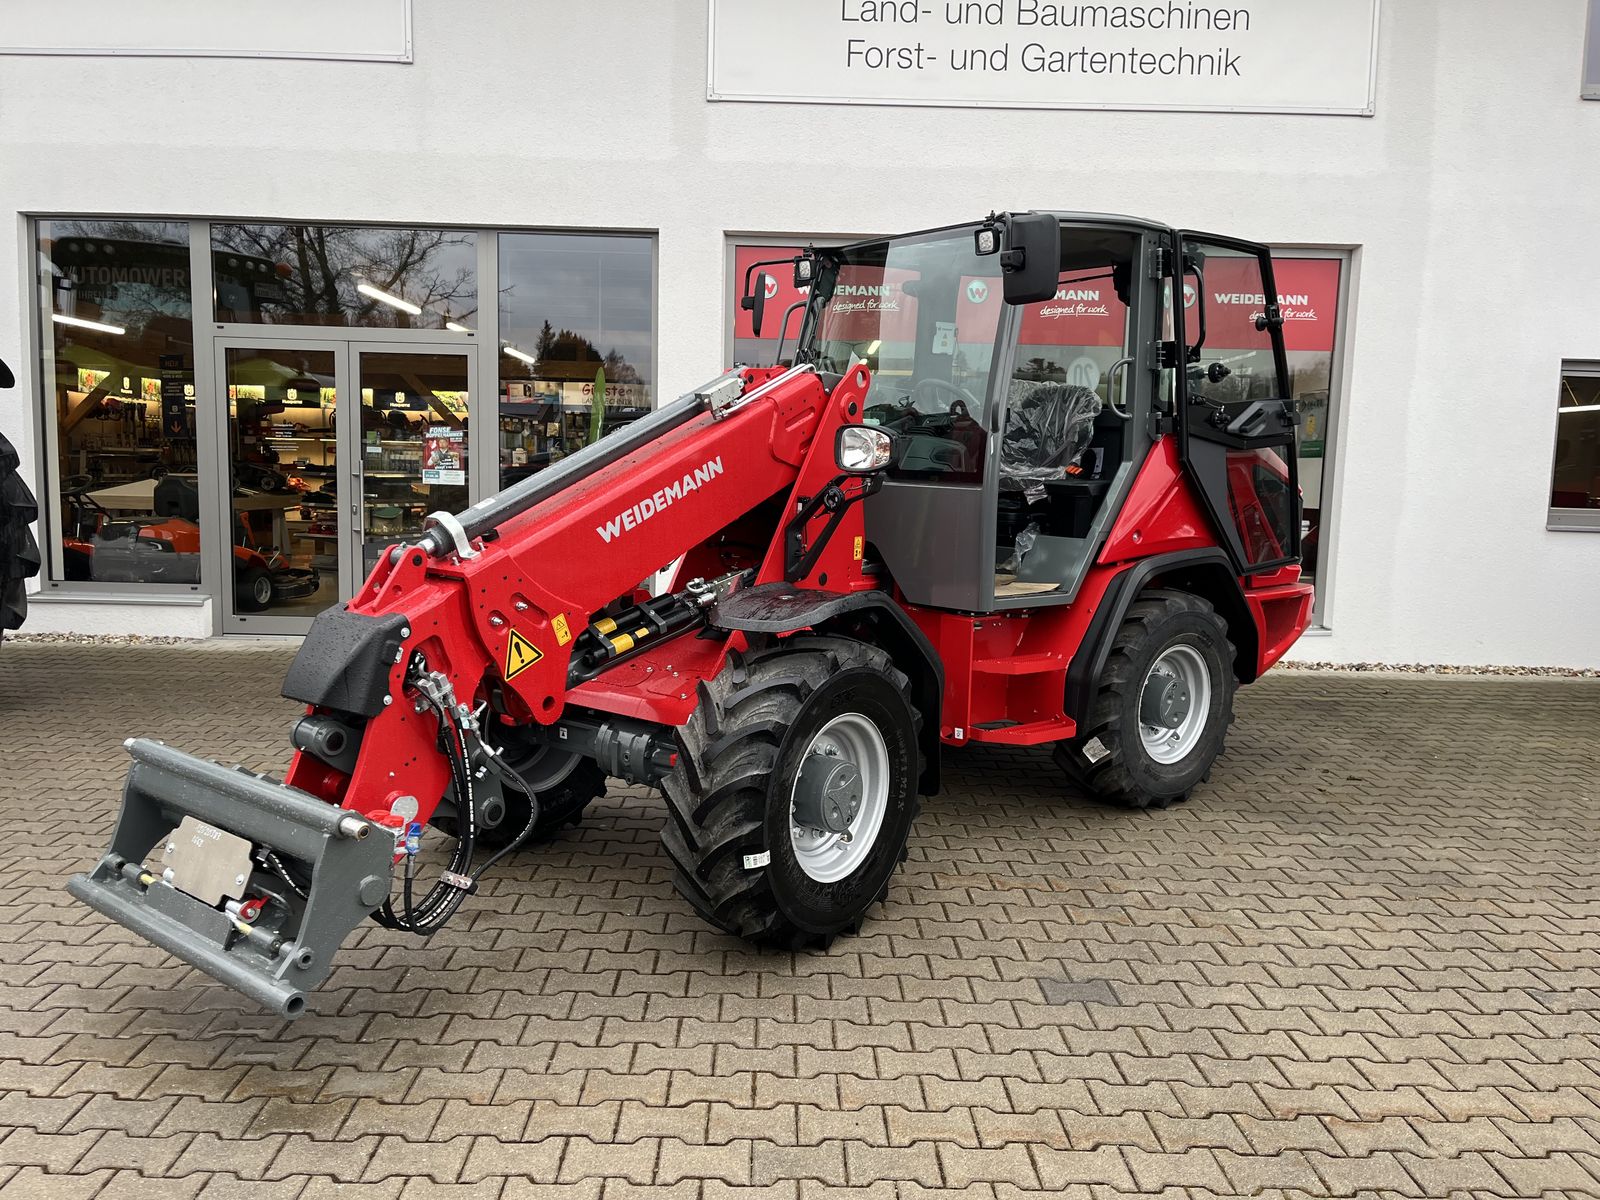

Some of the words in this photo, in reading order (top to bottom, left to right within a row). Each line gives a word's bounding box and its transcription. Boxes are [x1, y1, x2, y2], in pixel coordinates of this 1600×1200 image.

[841, 0, 932, 23] Land-
[945, 0, 1004, 25] und
[1017, 0, 1250, 31] Baumaschinen
[847, 39, 937, 69] Forst-
[951, 43, 1008, 71] und
[1021, 43, 1241, 76] Gartentechnik
[66, 266, 186, 288] UTOMOWER
[833, 300, 865, 315] designed
[866, 299, 879, 312] for
[1214, 293, 1308, 306] WEIDEANN
[1040, 305, 1074, 319] designed
[1075, 303, 1087, 317] for
[1087, 305, 1109, 315] work
[1284, 308, 1296, 321] for
[1296, 309, 1317, 319] work
[596, 455, 723, 543] WEIDEMANN
